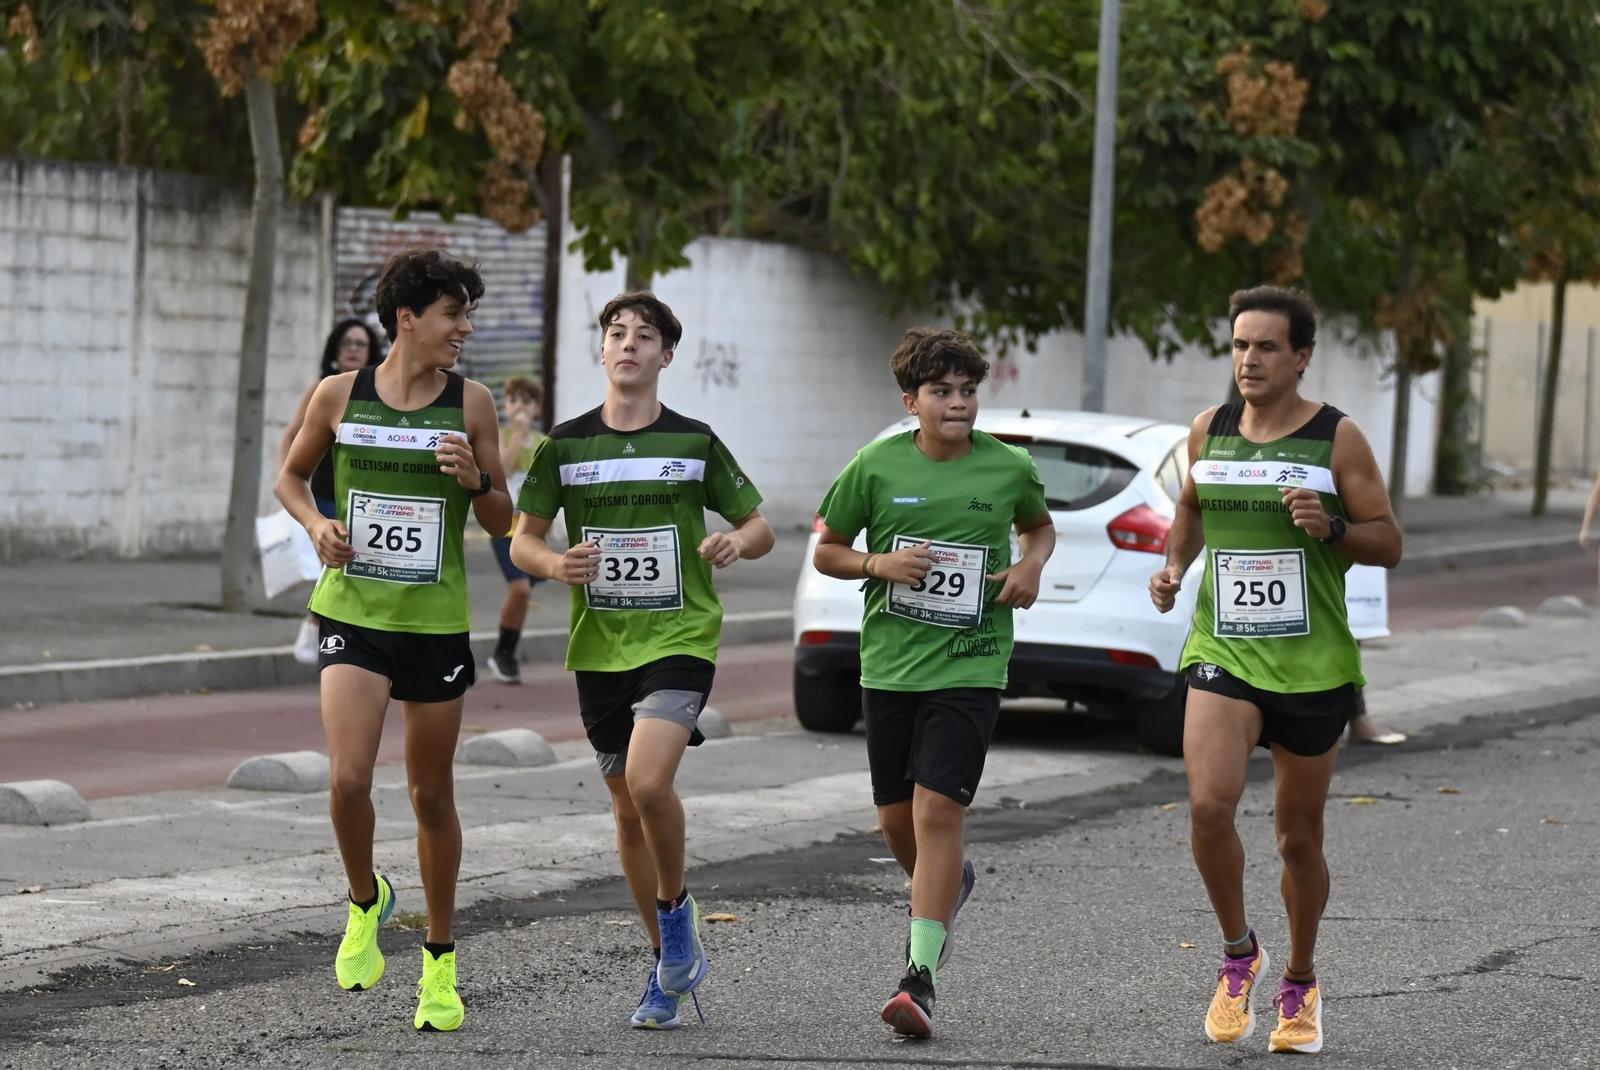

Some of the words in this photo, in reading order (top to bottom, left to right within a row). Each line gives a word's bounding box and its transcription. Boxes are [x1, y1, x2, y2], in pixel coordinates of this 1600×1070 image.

[350, 458, 399, 473] ATLETISMO
[402, 463, 448, 476] CORDOB
[377, 503, 415, 511] FESTIVAL
[1200, 498, 1248, 512] ATLETISMO
[1252, 500, 1292, 513] CORDO
[368, 523, 422, 553] 265
[930, 549, 960, 558] STIVAL
[377, 566, 389, 576] 5k
[605, 557, 660, 581] 323
[1233, 580, 1286, 606] 250
[621, 597, 633, 606] 3k
[920, 610, 932, 619] 3k
[1244, 623, 1256, 632] 5k
[947, 637, 1000, 657] LANZA
